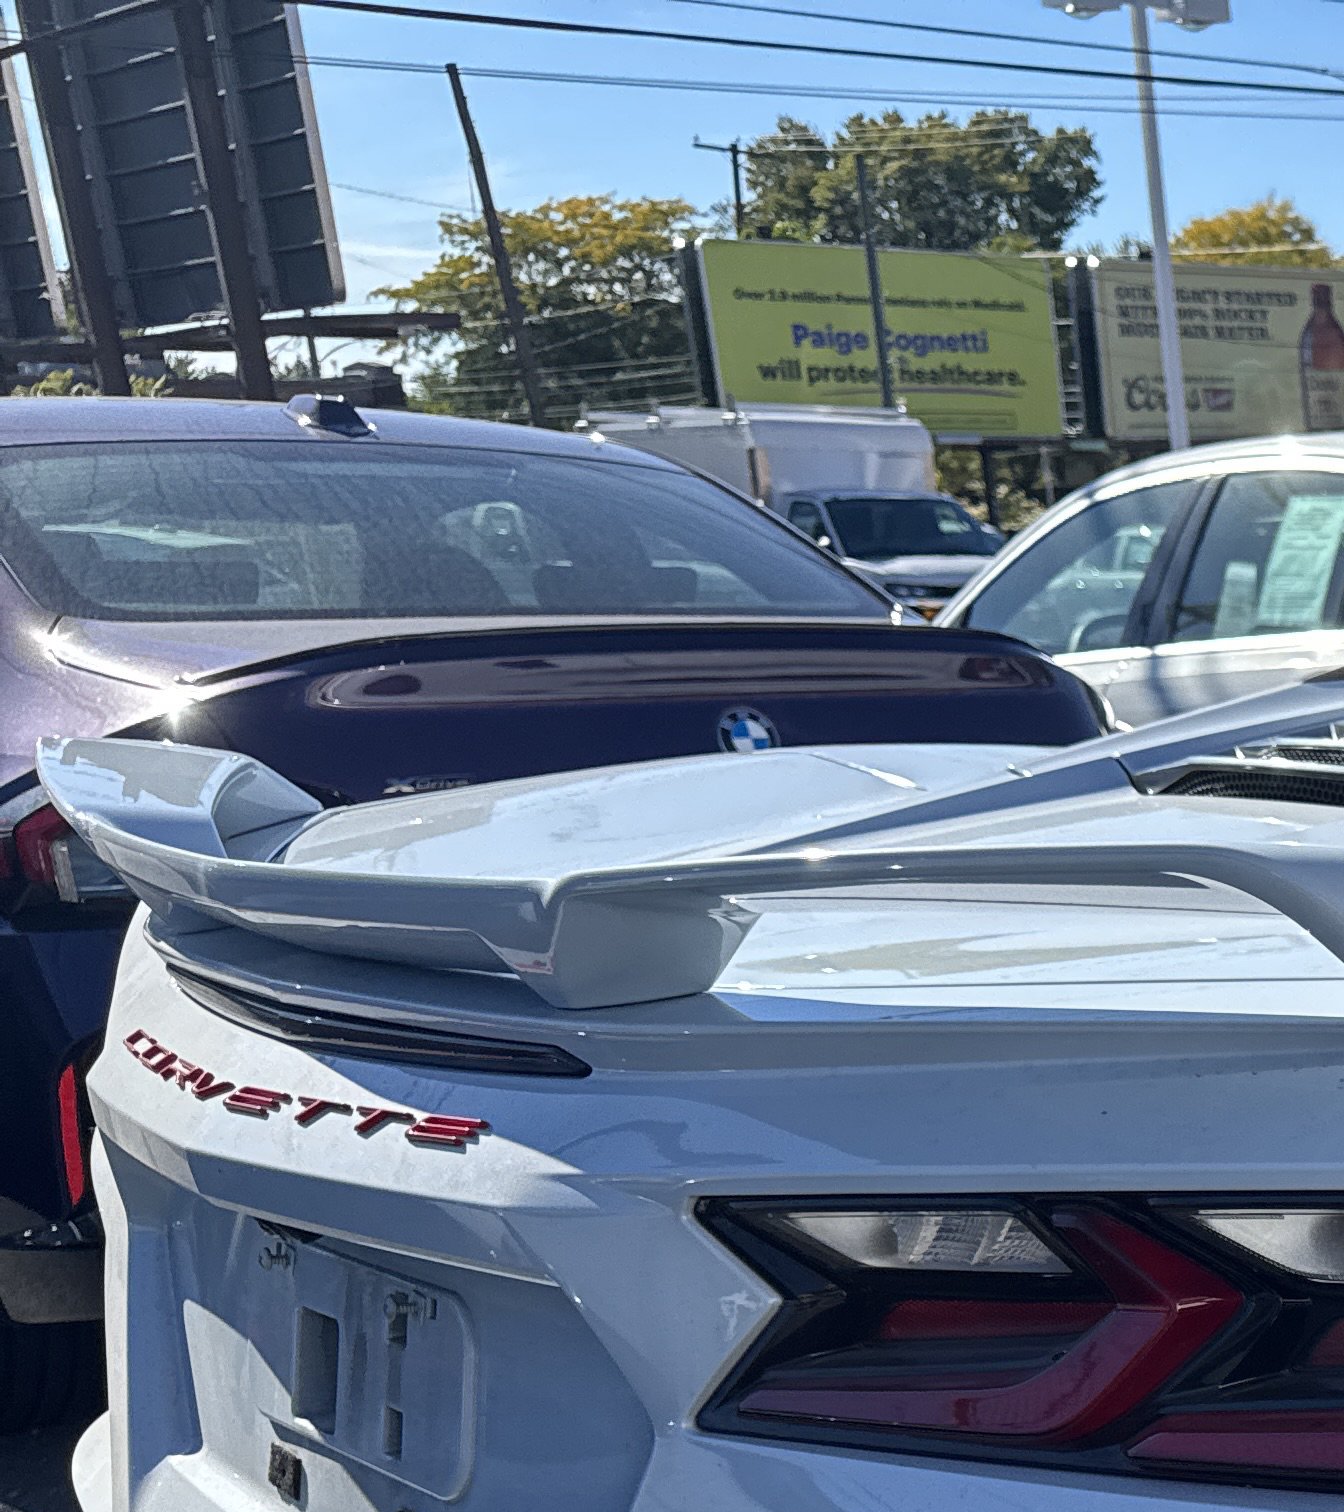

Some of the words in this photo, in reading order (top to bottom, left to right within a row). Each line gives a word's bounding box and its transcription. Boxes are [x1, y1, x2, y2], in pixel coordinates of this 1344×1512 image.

[790, 323, 870, 357] Paige
[757, 357, 802, 383] will
[807, 361, 884, 387] protec
[122, 1028, 494, 1151] CORVETTE
